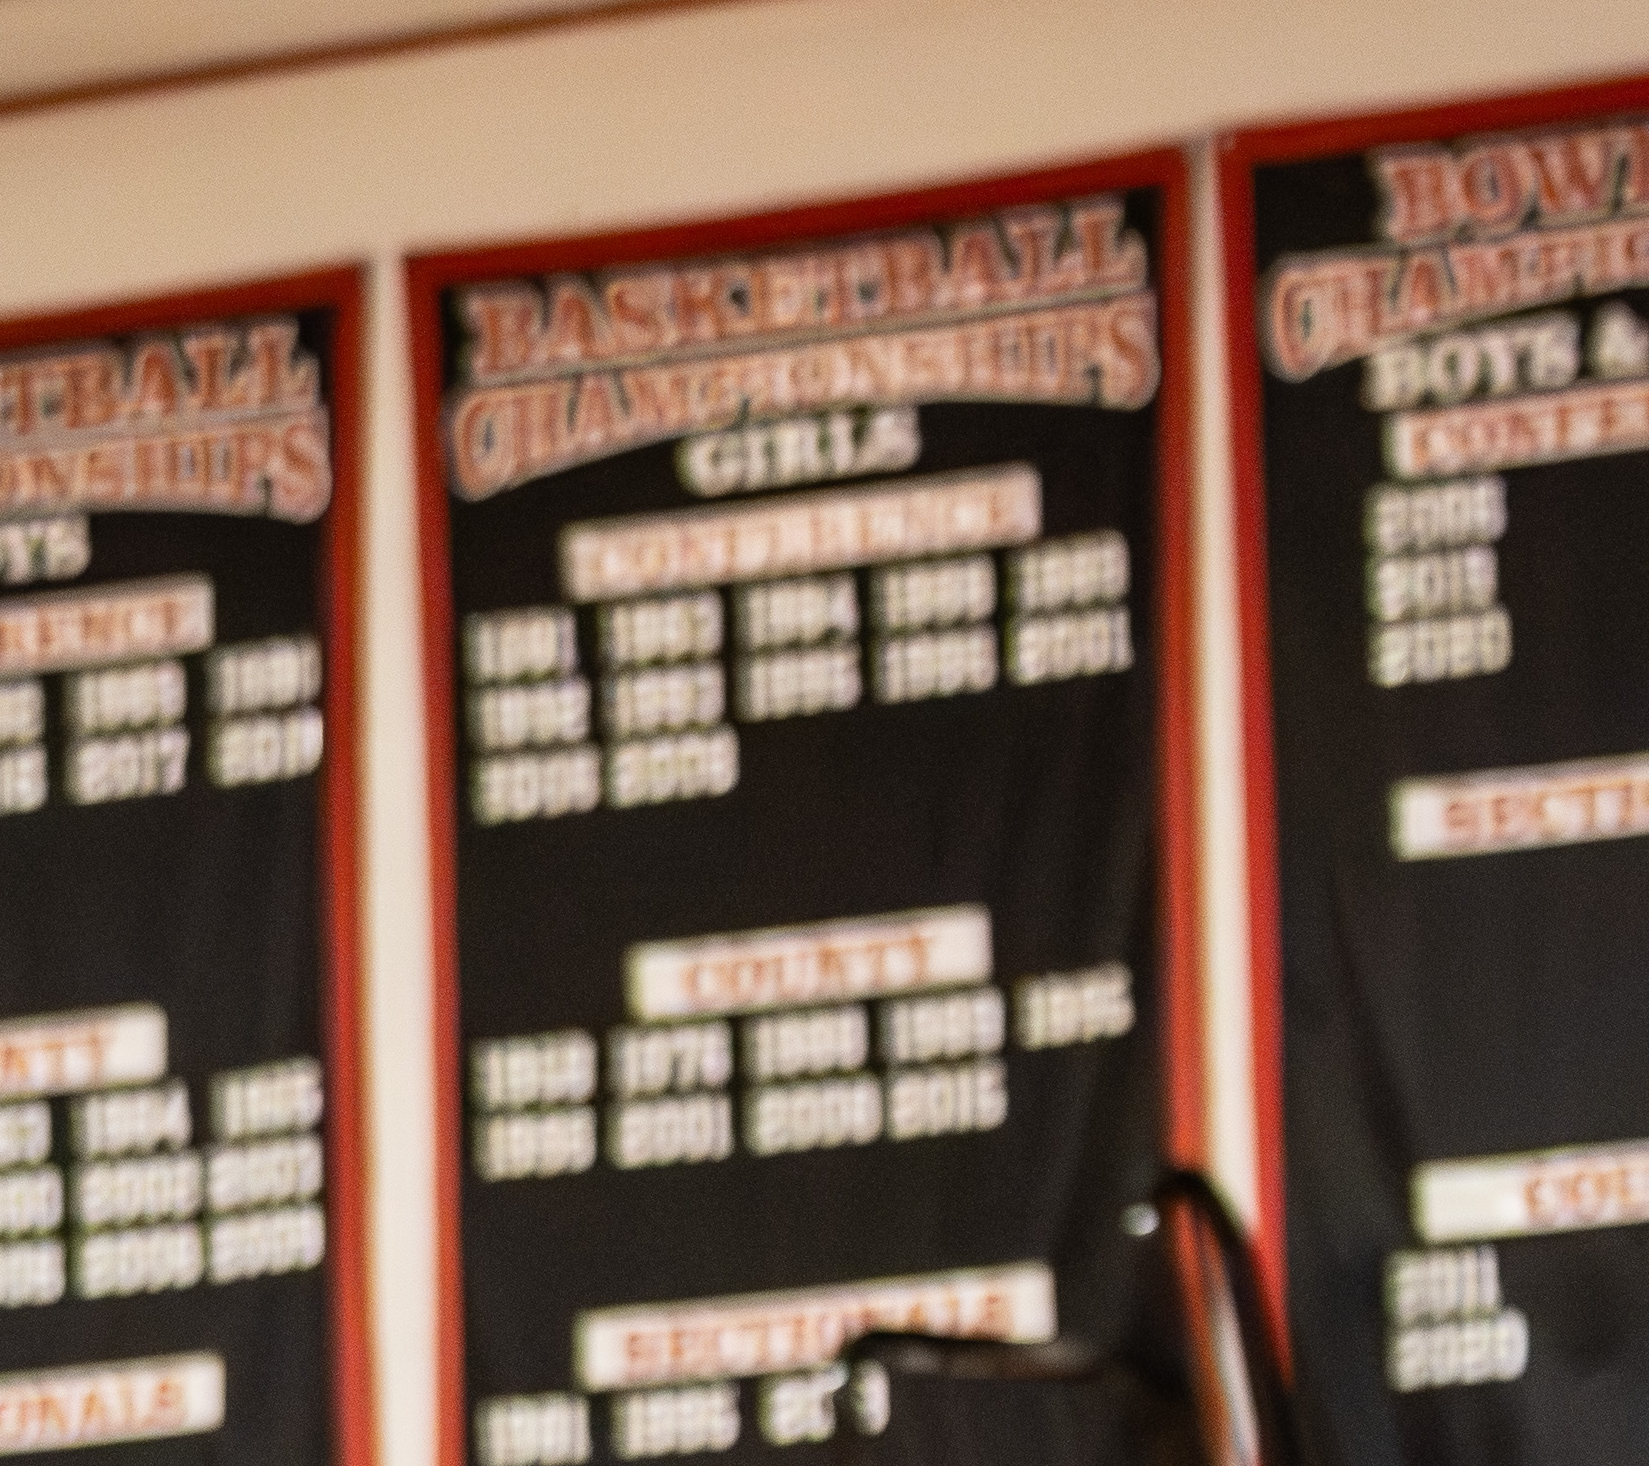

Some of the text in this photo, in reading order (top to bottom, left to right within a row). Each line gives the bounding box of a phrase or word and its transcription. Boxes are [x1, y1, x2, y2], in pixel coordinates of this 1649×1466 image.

[465, 198, 1148, 384] BASKETBALL
[446, 288, 1160, 502] CHAMPIONSHIPS
[1362, 314, 1580, 412] BOYS
[680, 403, 921, 498] GIRLS
[1407, 390, 1649, 472] CONFE
[1444, 772, 1649, 846] SECTI
